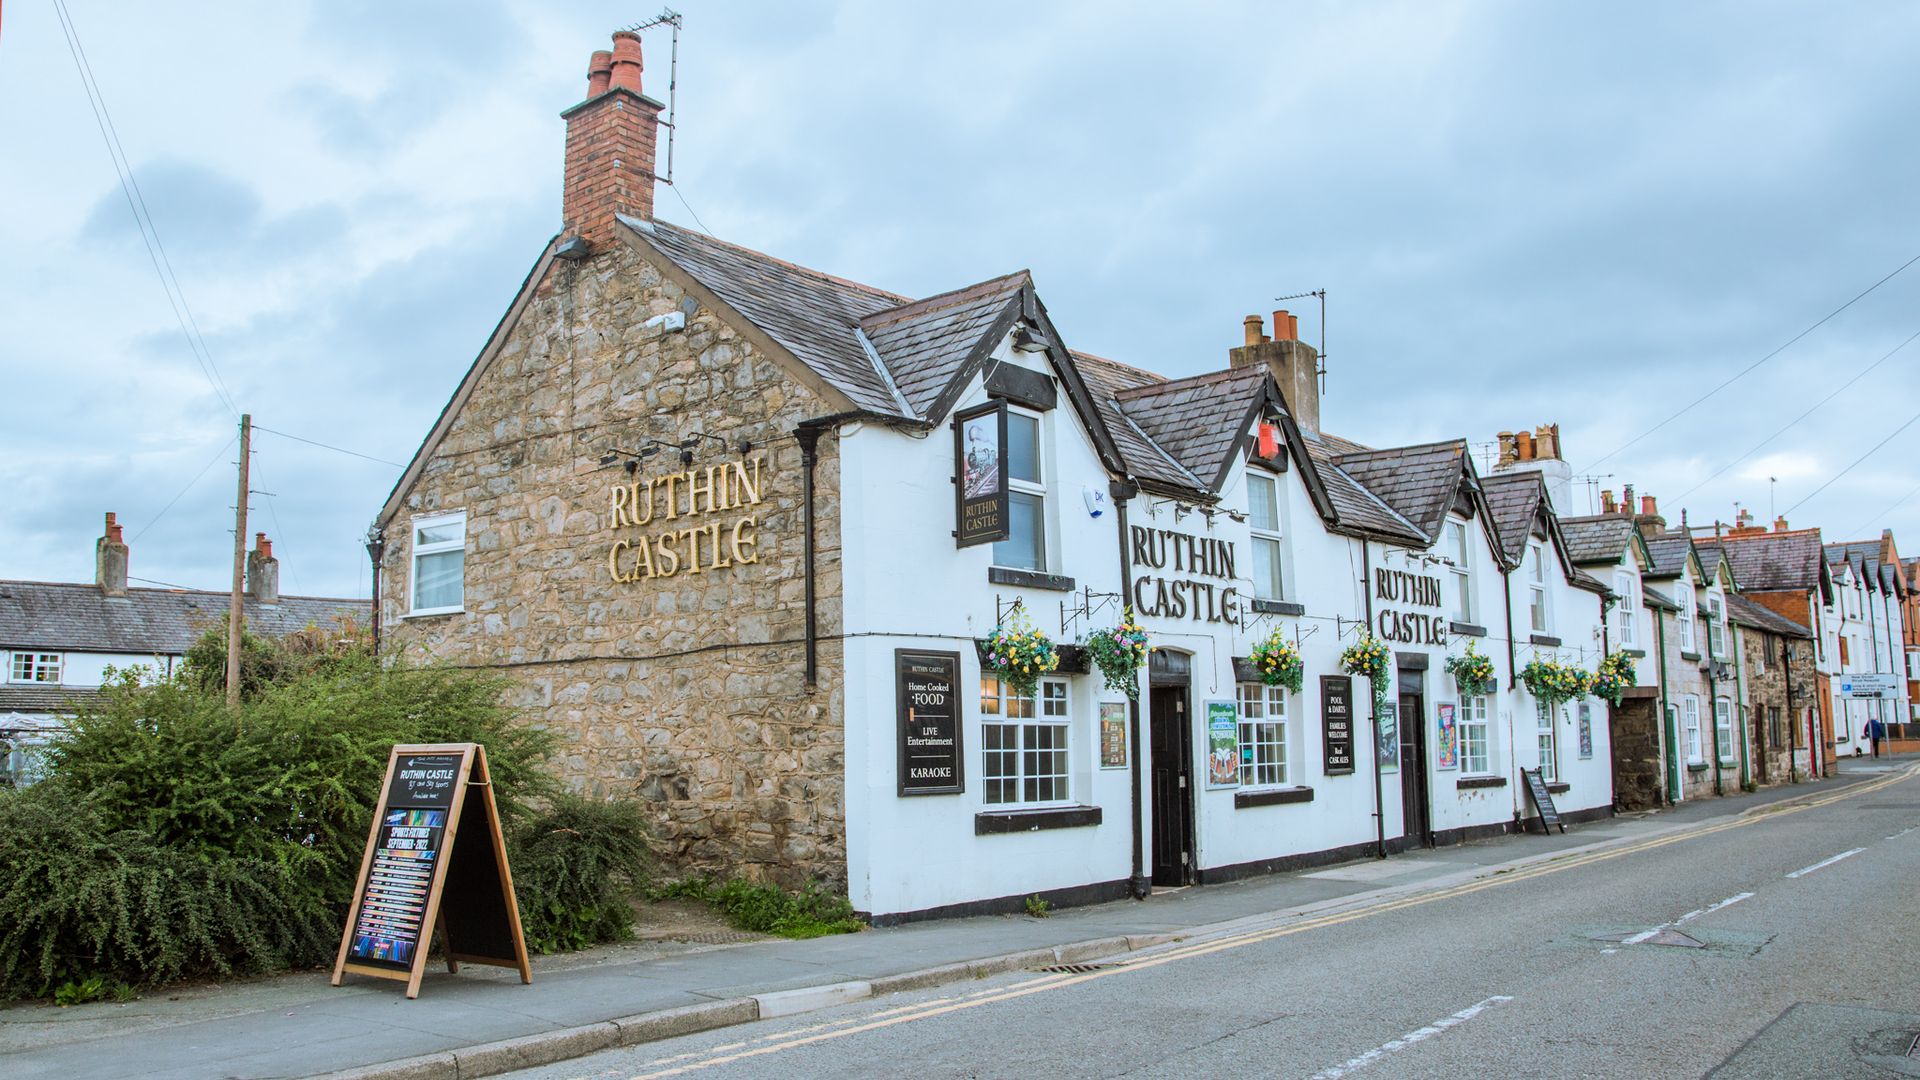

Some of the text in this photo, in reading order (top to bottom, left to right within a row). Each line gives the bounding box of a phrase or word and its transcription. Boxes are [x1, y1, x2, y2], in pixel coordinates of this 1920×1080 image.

[610, 457, 762, 529] RUTHIN
[966, 500, 998, 517] RUTHIN
[966, 514, 998, 531] CASTLE
[609, 516, 759, 583] CASTLE
[1131, 525, 1237, 580] RUTHIN
[1376, 567, 1441, 608] RUTHIN
[1135, 575, 1239, 625] CASTLE
[1380, 609, 1446, 647] CASTLE
[908, 682, 949, 692] Home Cooked
[1330, 696, 1343, 705] POOL
[1332, 705, 1346, 714] DARTS
[922, 727, 938, 736] LIVE
[1329, 722, 1346, 730] FAMILIES
[1327, 731, 1348, 739] WELCOME
[907, 736, 953, 746] Entertainment
[400, 769, 454, 780] RUTHIN CASTLE
[911, 767, 951, 778] KARAOKE
